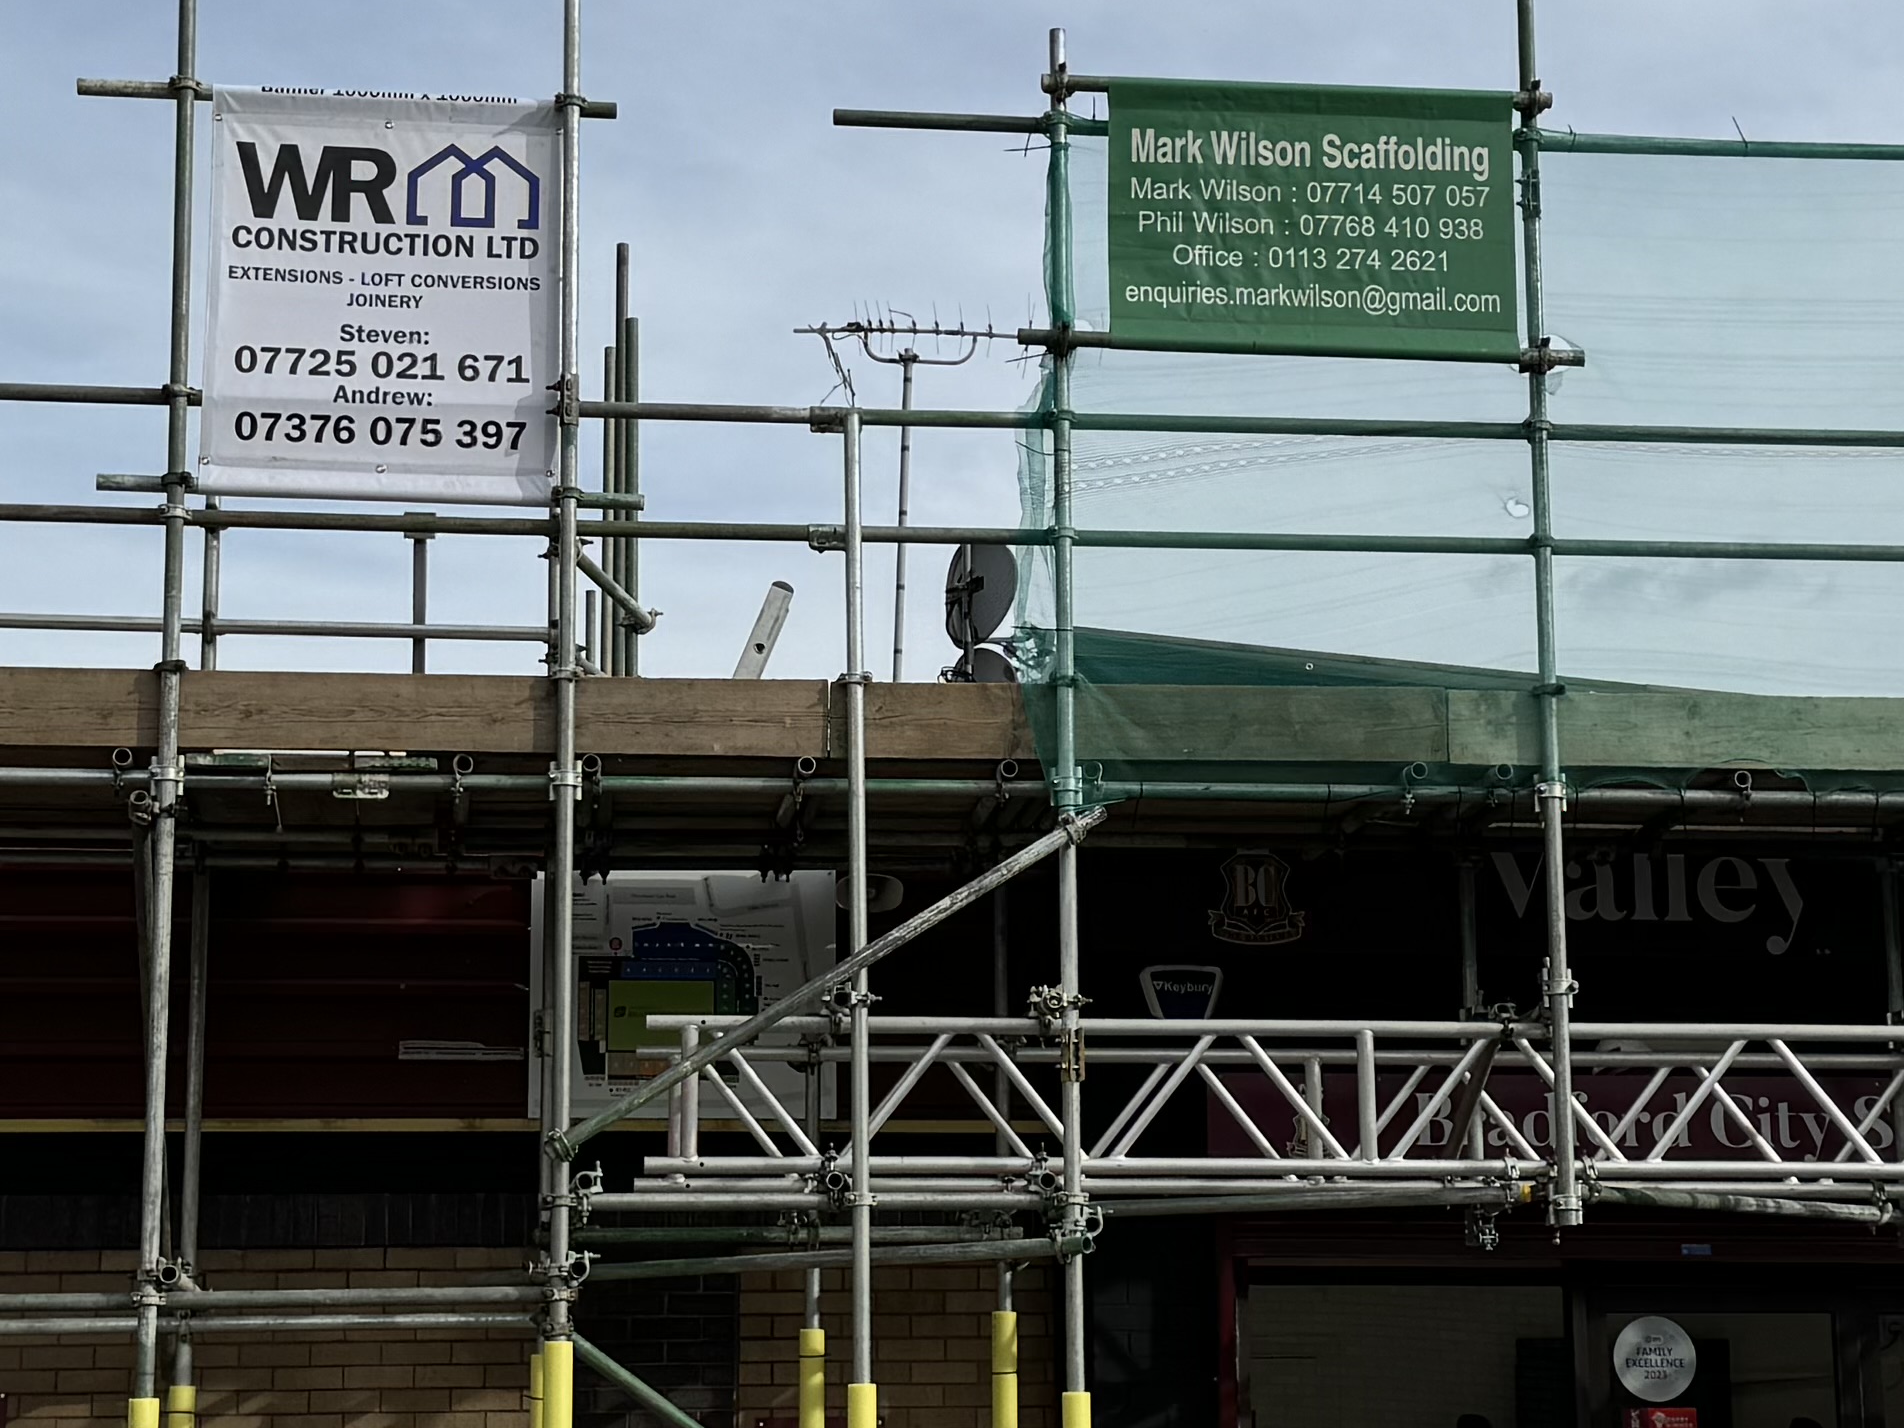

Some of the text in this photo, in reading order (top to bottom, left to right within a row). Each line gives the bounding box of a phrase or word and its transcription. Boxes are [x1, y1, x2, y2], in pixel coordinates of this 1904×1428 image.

[1131, 128, 1489, 182] Mark Wilson Scaffolding
[236, 141, 397, 224] WR
[1131, 177, 1191, 200] Mark
[1200, 179, 1281, 202] Wilson
[1307, 182, 1381, 205] 07714
[1392, 184, 1436, 206] 507
[1446, 185, 1489, 208] 057
[1138, 211, 1184, 234] Phil
[1193, 212, 1274, 236] Wilson
[1300, 215, 1375, 238] 07768
[1384, 217, 1429, 239] 410
[1439, 219, 1483, 240] 938
[232, 225, 540, 259] CONSTRUCTION LTD
[1173, 244, 1243, 268] Office
[1269, 248, 1326, 270] 0113
[1336, 249, 1381, 271] 274
[1391, 250, 1449, 272] 2621
[228, 266, 343, 285] EXTENSIONS
[360, 272, 403, 287] LOFT
[410, 274, 540, 291] CONVERSIONS
[347, 292, 422, 309] JOINERY
[1125, 282, 1500, 315] enquiries.markwilson@gmail.com
[339, 324, 430, 345] Steven:
[234, 346, 530, 383] 07725 021 671
[333, 385, 433, 406] Andrew:
[234, 412, 527, 450] 07376 075 397
[1489, 852, 1804, 955] Valley
[1164, 981, 1214, 995] Keybury
[1414, 1088, 1693, 1149] Badford
[1710, 1093, 1832, 1162] City
[1625, 1357, 1685, 1369] EXCELLENCE
[1637, 1348, 1673, 1356] FAMILY
